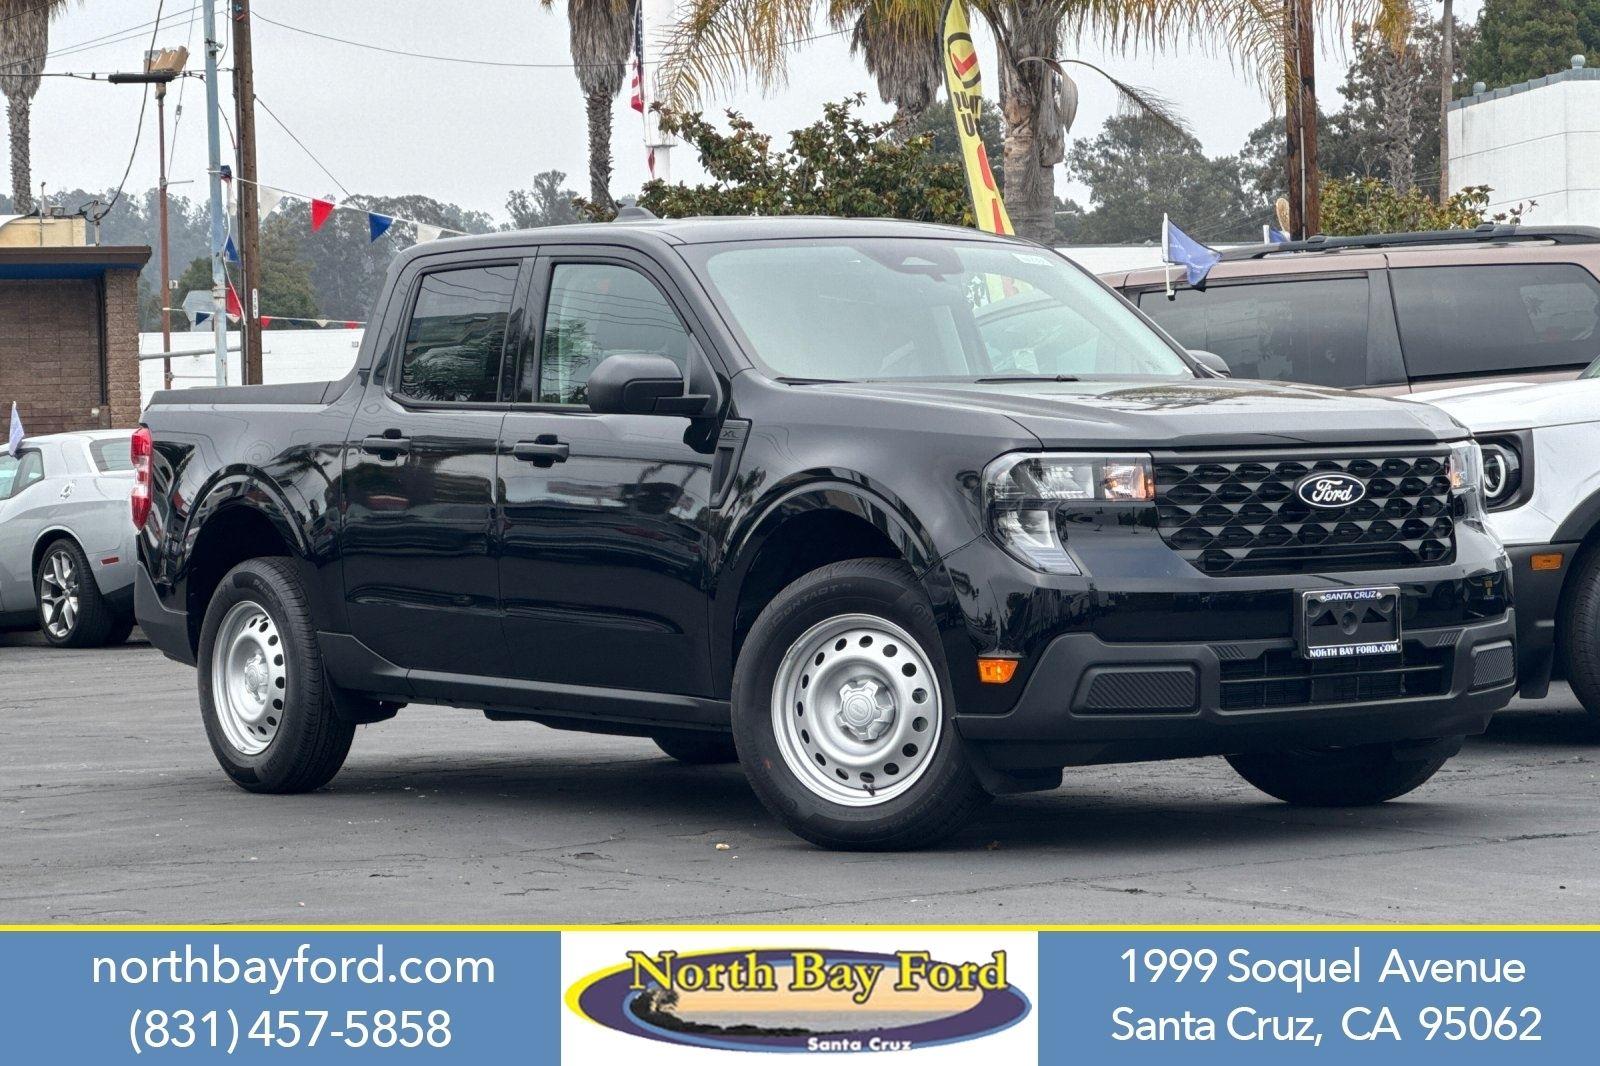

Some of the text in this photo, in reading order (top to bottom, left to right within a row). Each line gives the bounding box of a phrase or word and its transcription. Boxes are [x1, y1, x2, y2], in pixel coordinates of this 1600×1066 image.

[1312, 479, 1354, 501] Ford
[1325, 590, 1377, 601] SANTA CRUZ
[1309, 643, 1398, 658] NORTH BAY FORD.COM
